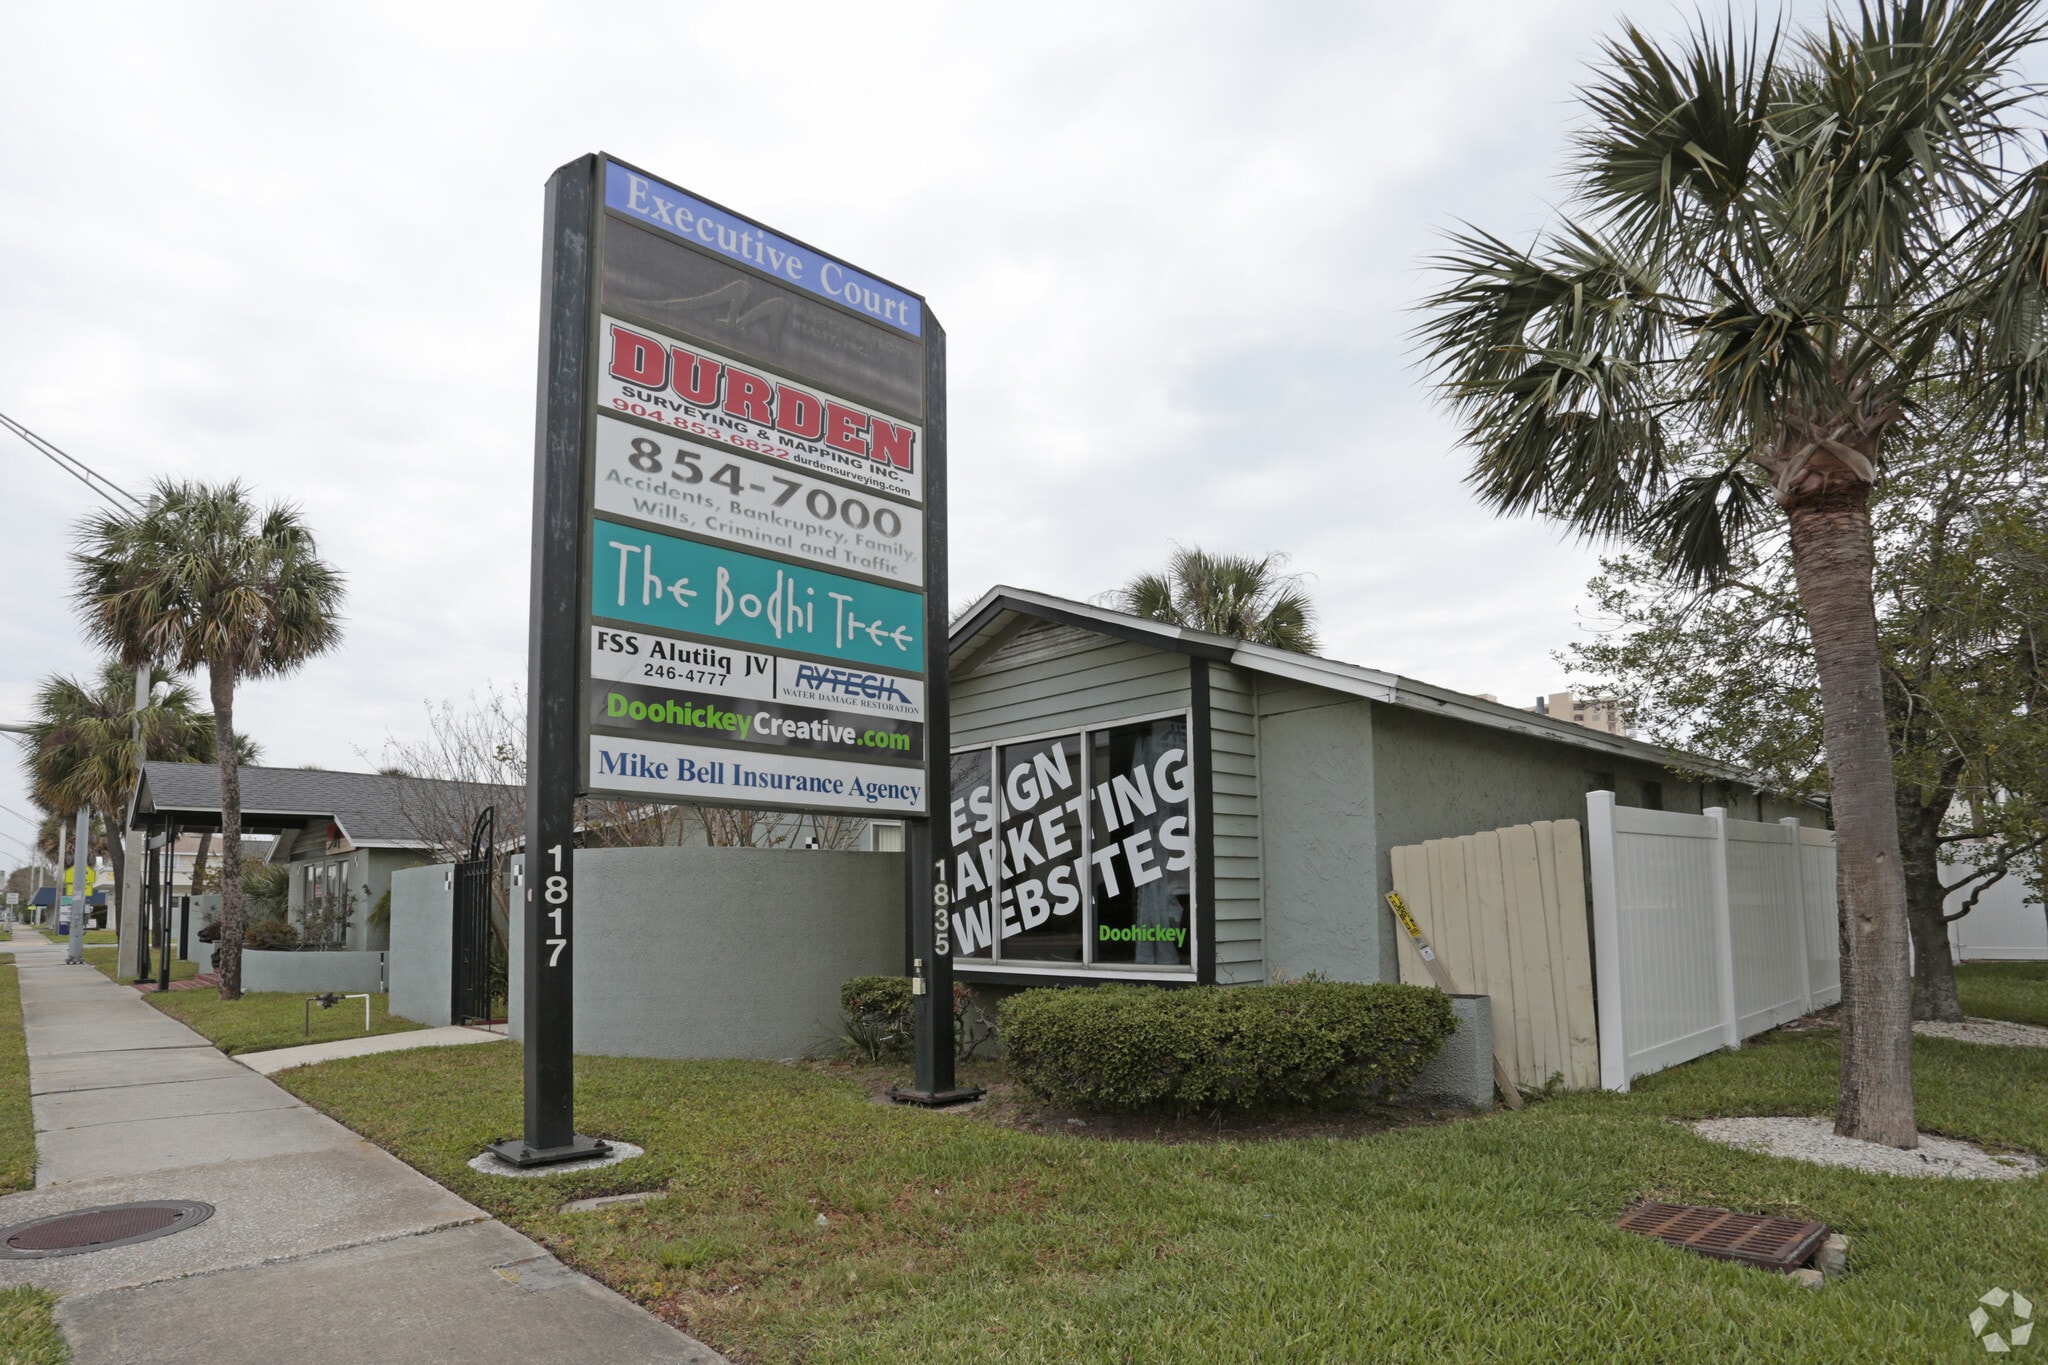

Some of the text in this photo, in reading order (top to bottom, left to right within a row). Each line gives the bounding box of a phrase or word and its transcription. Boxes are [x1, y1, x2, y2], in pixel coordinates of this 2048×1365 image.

[626, 172, 909, 326] Executive Court
[609, 323, 915, 474] DURDEN
[612, 397, 790, 461] 904.853.6822
[621, 385, 904, 482] SURVEYING & MAPPING INC.
[605, 468, 918, 563] Accidents, Bankruptcy, Family,
[628, 437, 902, 538] 854-7000
[793, 454, 911, 497] durdensurveying.com
[633, 497, 899, 575] Wills, Criminal and Traffic
[609, 541, 913, 651] The Bodhi Tree
[597, 630, 768, 678] FSS Alutiiq JV
[644, 663, 728, 687] 246-4777
[795, 664, 912, 705] RYTECH
[608, 692, 911, 751] DoohickeyCreative.com
[783, 687, 920, 715] WATER DAMAGE RESTORATION
[598, 749, 921, 806] Mike Bell Insurance Agency
[951, 741, 1073, 847] ESGN
[951, 748, 1189, 904] ARKEING
[544, 844, 568, 967] 1817
[934, 858, 950, 956] 1835
[1099, 923, 1187, 948] Doohickey
